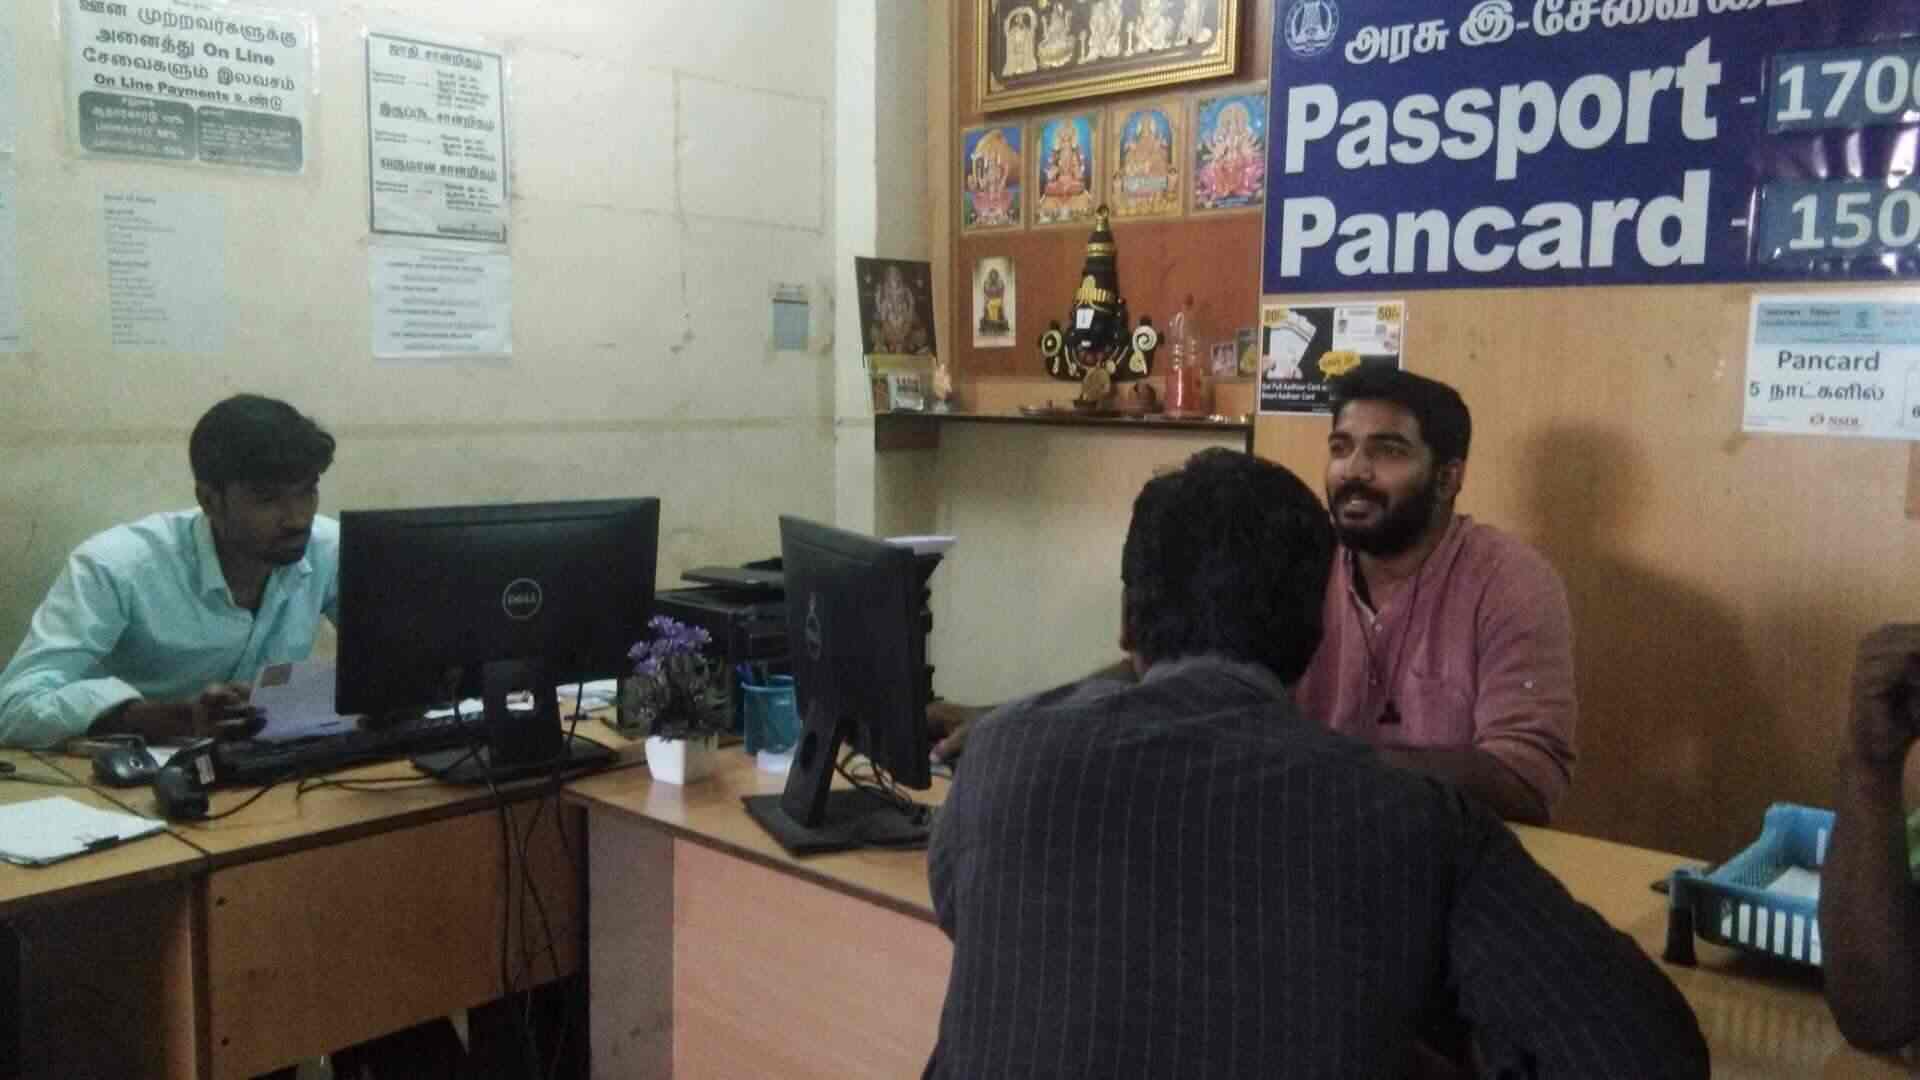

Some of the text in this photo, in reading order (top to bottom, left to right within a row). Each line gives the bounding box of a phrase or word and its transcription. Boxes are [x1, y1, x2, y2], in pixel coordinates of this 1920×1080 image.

[203, 42, 229, 58] On
[236, 47, 275, 66] Line
[1344, 19, 1449, 64] அரசு
[94, 73, 117, 88] On
[121, 77, 153, 91] Line
[158, 82, 230, 102] Payments
[1284, 36, 1721, 181] Passport
[1776, 55, 1920, 122] 170
[1280, 170, 1711, 278] Pancard
[1778, 349, 1881, 371] Pancard
[1750, 381, 1885, 403] 5 நாட்களில்
